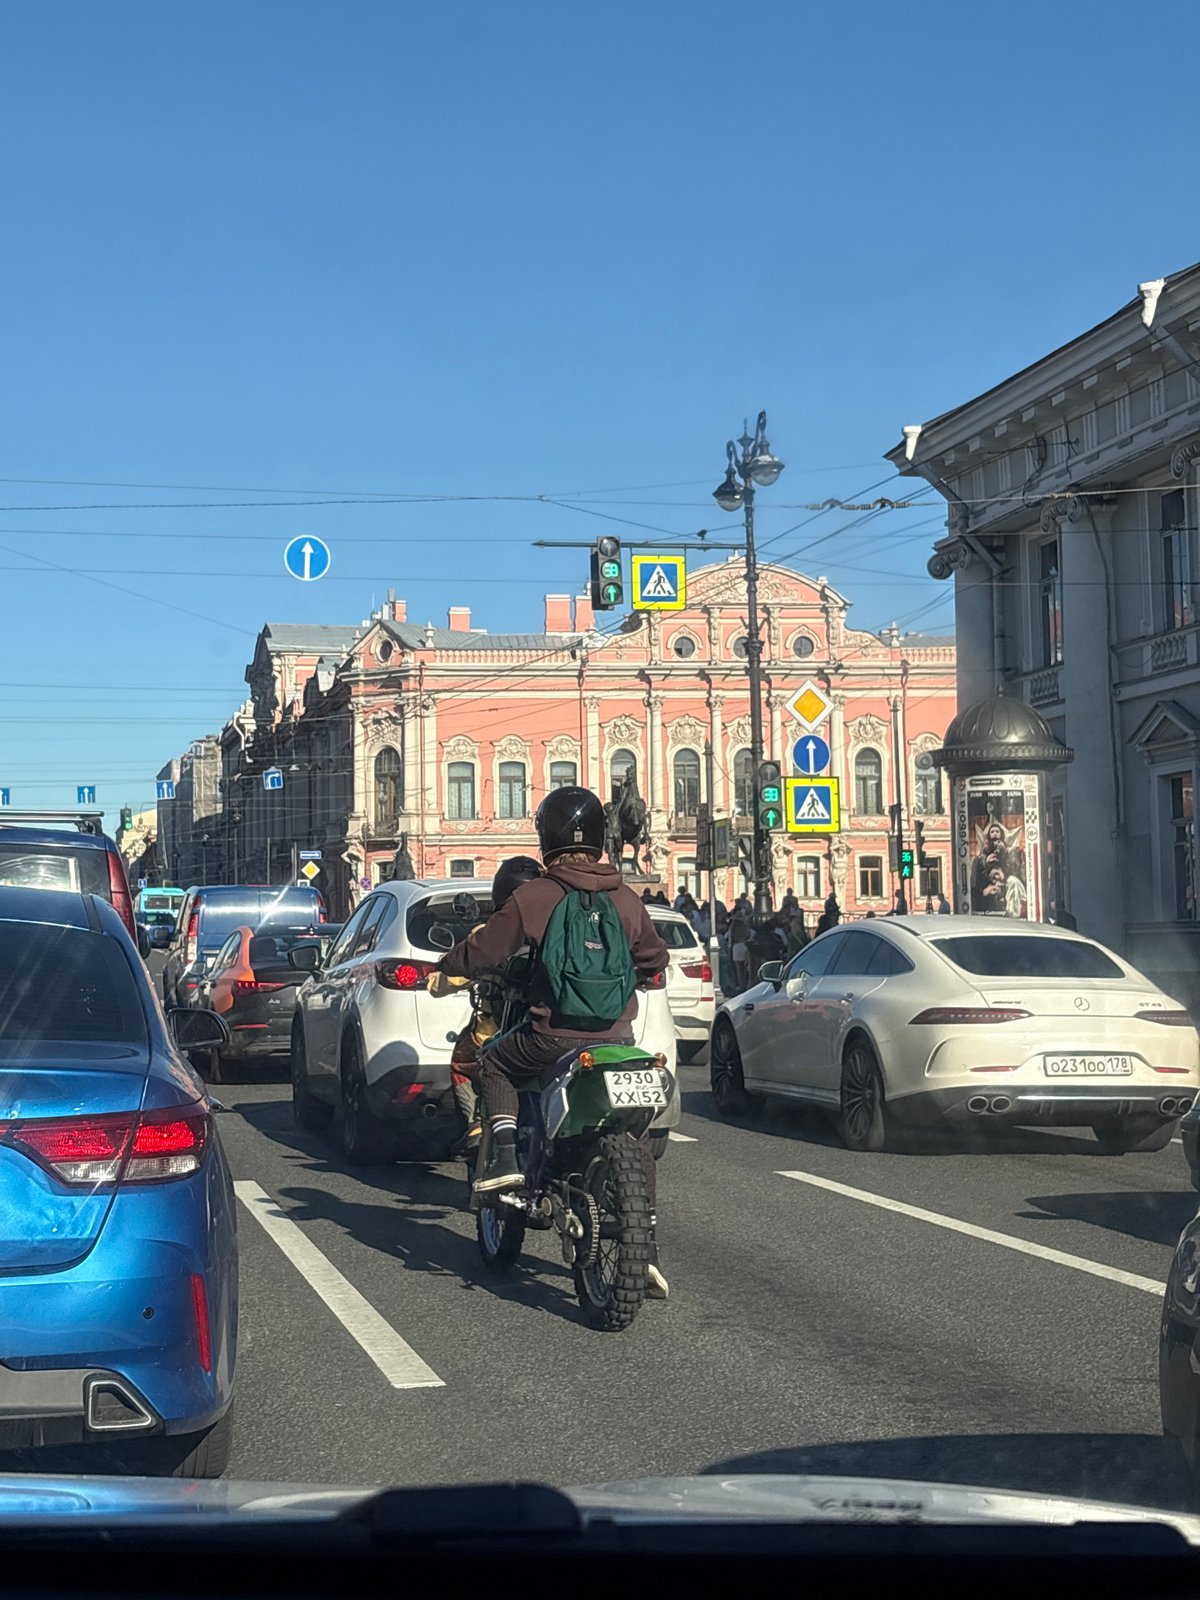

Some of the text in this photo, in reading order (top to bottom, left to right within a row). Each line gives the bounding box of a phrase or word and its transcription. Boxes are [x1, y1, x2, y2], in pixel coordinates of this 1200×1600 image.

[1107, 1057, 1128, 1072] 178
[612, 1072, 654, 1085] 2930
[641, 1090, 664, 1104] 52
